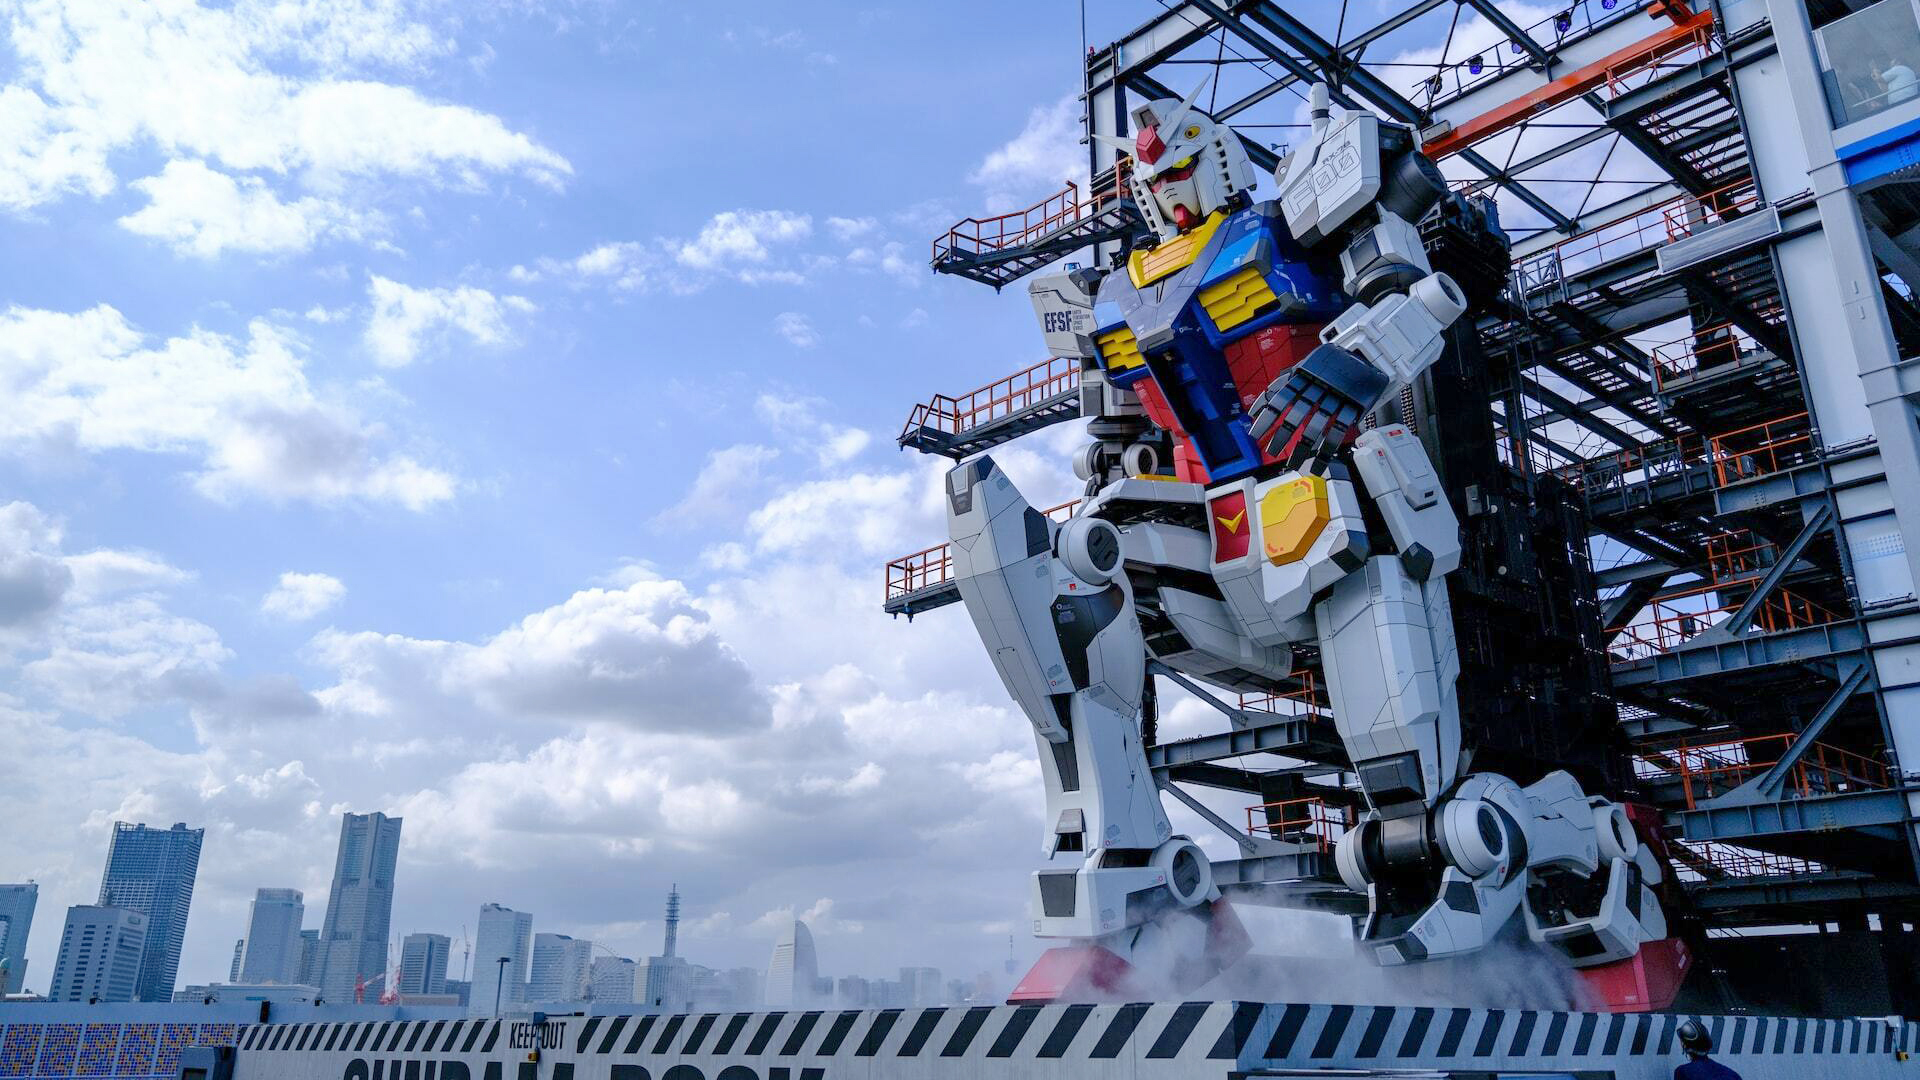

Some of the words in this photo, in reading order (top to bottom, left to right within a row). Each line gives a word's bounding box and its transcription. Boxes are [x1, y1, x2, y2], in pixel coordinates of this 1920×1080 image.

[1044, 310, 1072, 333] EFSF
[509, 1022, 538, 1049] KEEP
[541, 1022, 567, 1050] OUT
